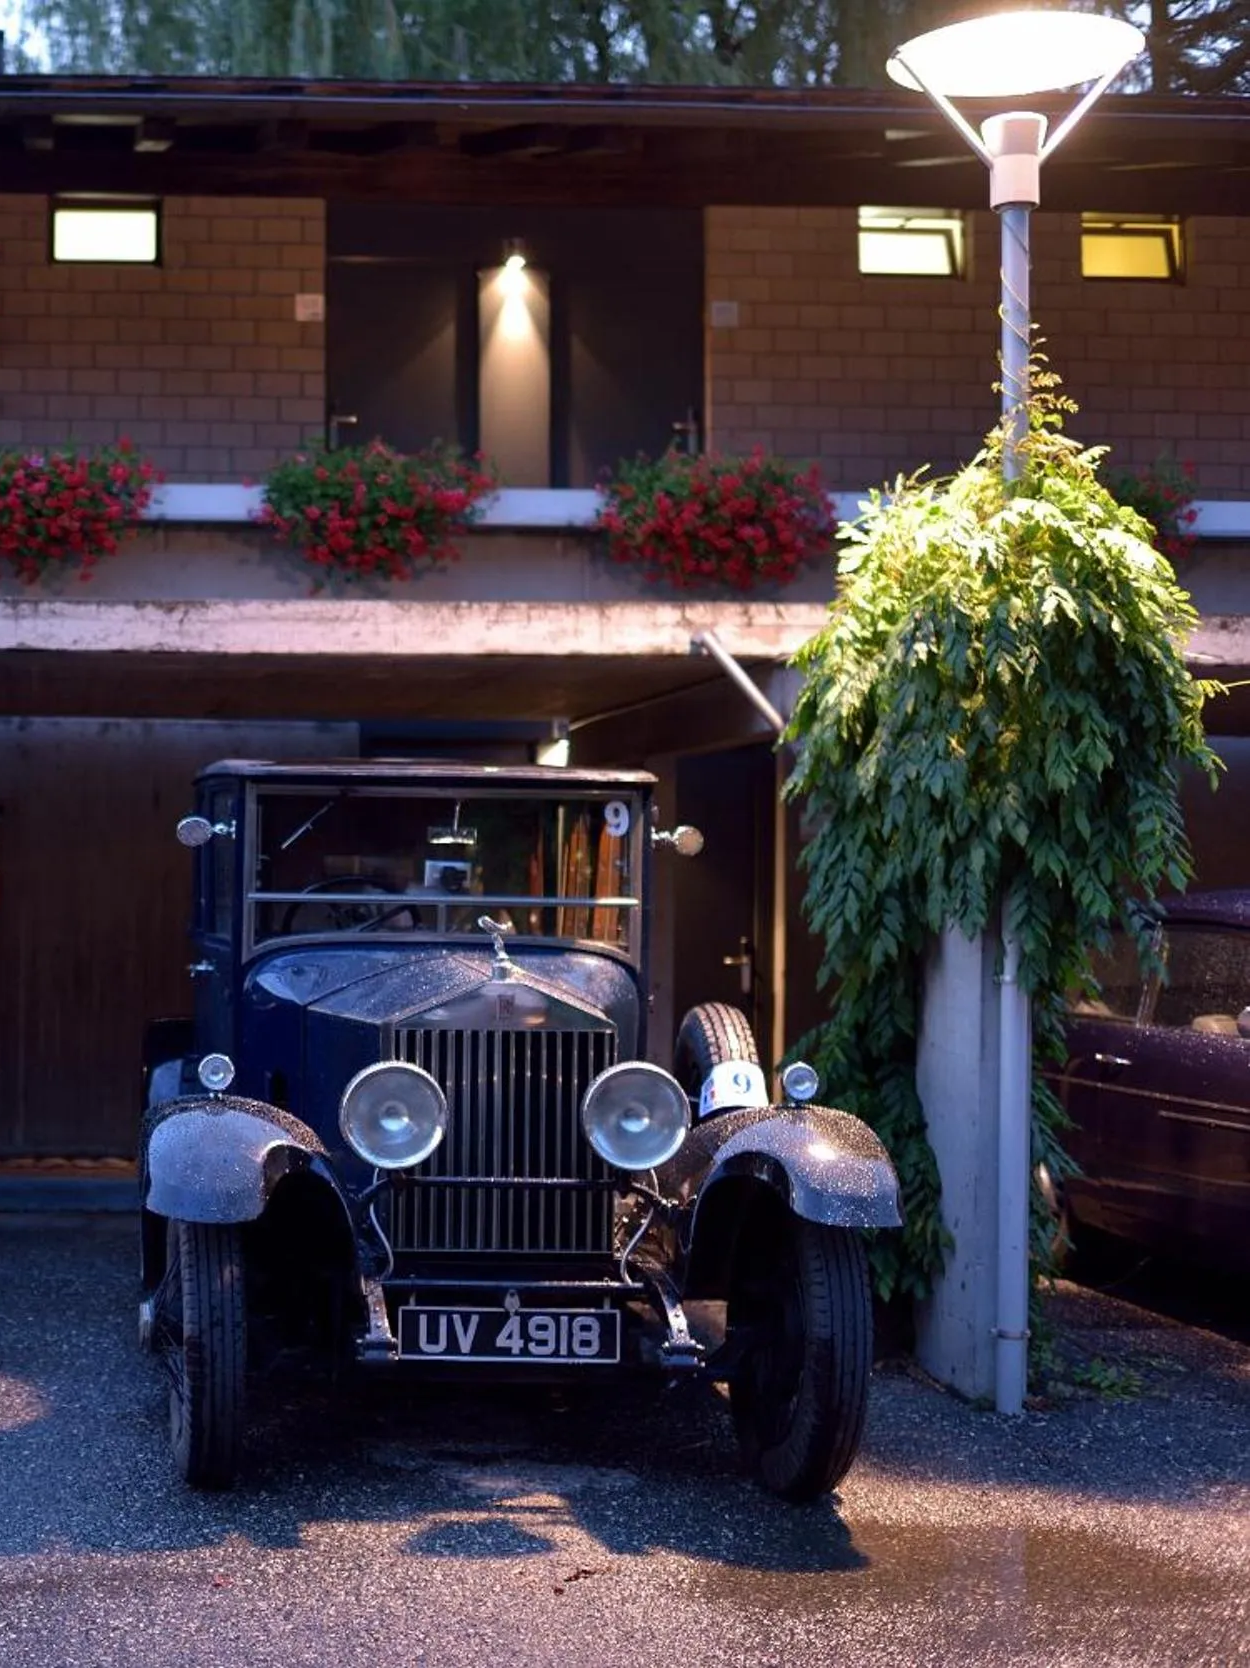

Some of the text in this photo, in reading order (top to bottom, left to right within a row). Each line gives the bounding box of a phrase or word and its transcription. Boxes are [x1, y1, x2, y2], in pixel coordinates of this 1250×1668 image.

[604, 800, 630, 837] 9
[732, 1072, 752, 1095] 9
[419, 1313, 600, 1356] UV 4918
